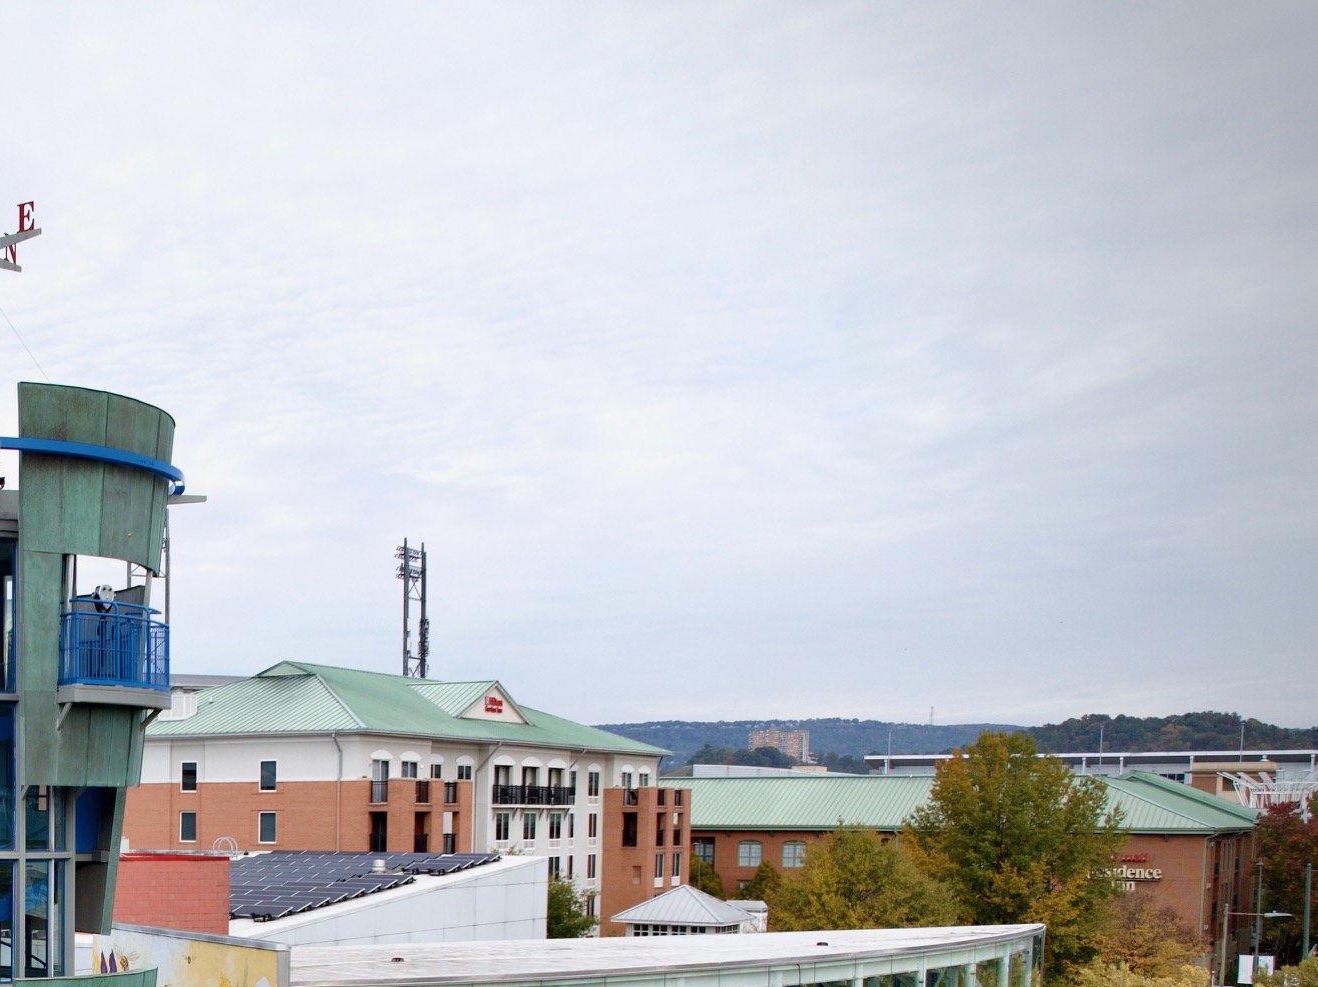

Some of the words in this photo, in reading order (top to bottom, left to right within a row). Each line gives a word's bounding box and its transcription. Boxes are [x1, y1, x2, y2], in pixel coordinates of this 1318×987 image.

[16, 201, 35, 233] E
[3, 232, 17, 265] N
[1086, 865, 1162, 879] esidence
